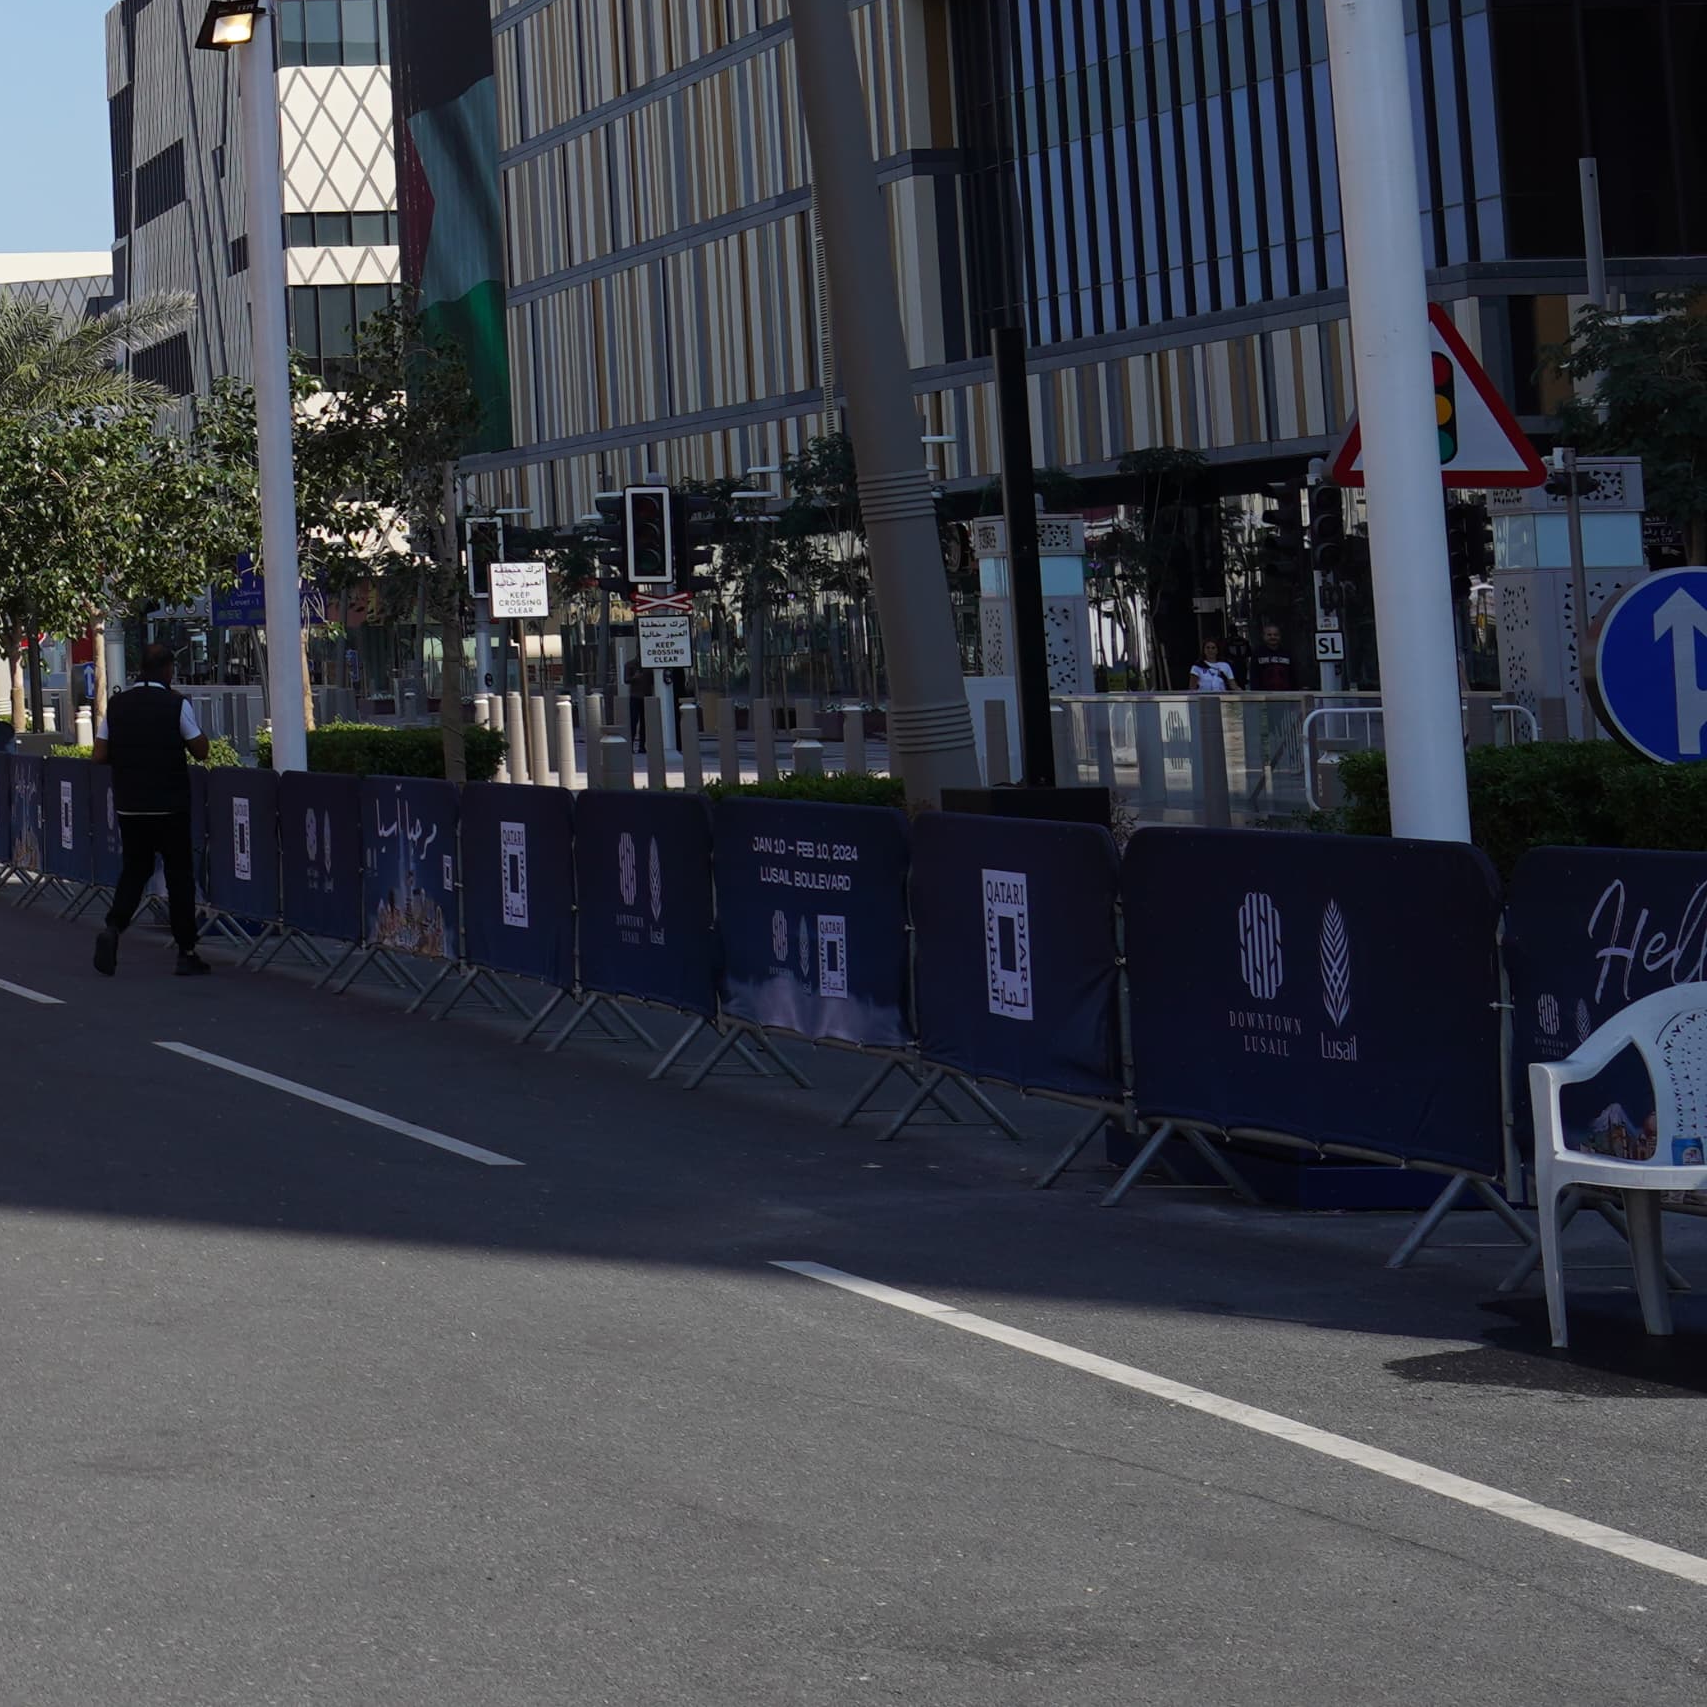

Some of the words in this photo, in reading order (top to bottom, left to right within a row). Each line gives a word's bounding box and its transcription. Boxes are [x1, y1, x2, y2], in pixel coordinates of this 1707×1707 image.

[498, 598, 542, 607] CROSSING
[509, 591, 531, 599] KEEP
[647, 648, 685, 656] CROSSING
[656, 641, 676, 649] KEEP
[1318, 637, 1342, 655] SL
[752, 837, 773, 853] JAN
[774, 838, 786, 855] 10
[796, 840, 815, 858] FEB
[832, 844, 859, 862] 2024
[760, 865, 793, 886] LUSAIL
[794, 871, 852, 891] BOULEVARD
[986, 880, 1025, 907] QATARI
[819, 921, 844, 935] QATARI
[1017, 910, 1028, 983] DIAR
[1229, 1010, 1302, 1036] DOWNTOWN
[1243, 1034, 1290, 1057] LUSAIL
[1320, 1032, 1358, 1062] Lusail
